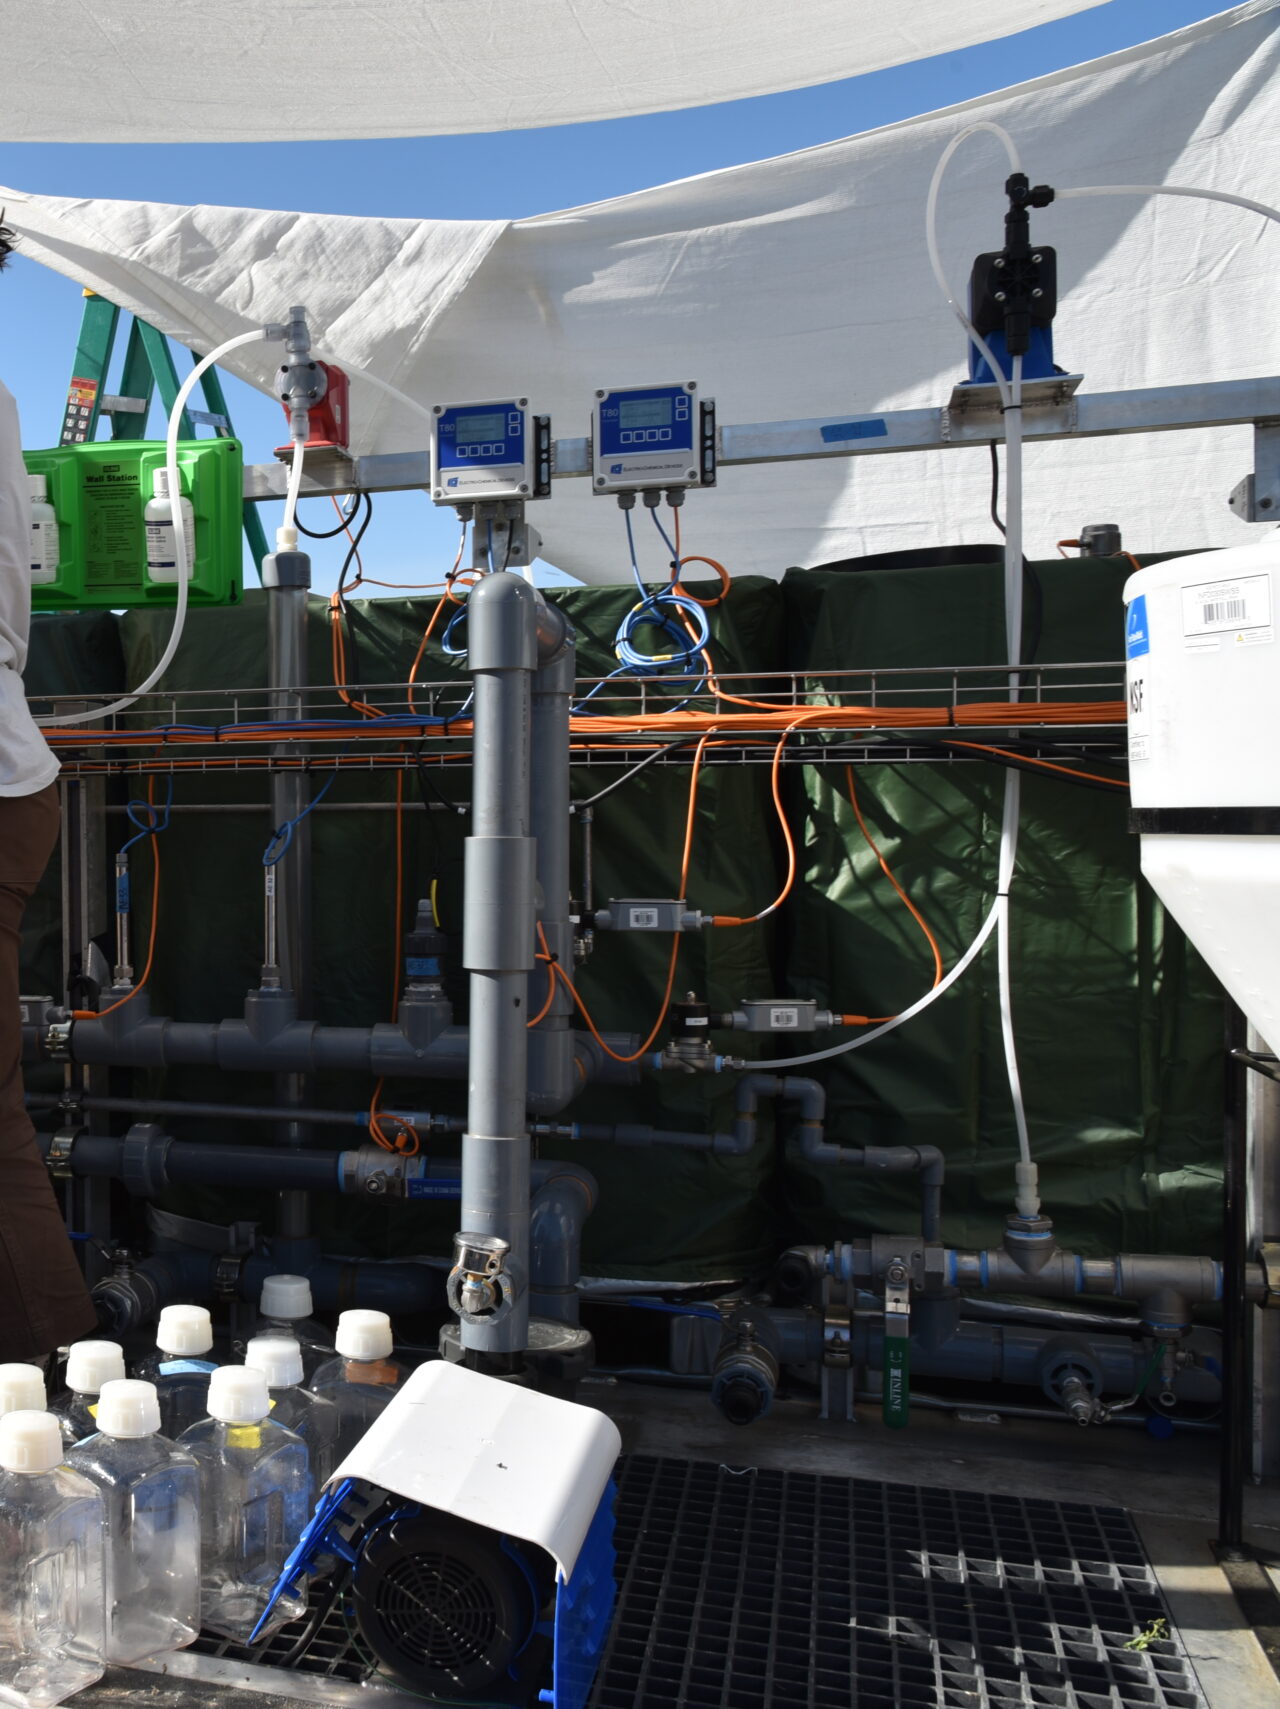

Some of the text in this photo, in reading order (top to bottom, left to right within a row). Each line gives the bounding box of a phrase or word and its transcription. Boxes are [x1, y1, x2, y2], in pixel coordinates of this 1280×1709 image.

[602, 408, 619, 417] T80
[439, 423, 455, 432] T80
[106, 474, 138, 482] Station
